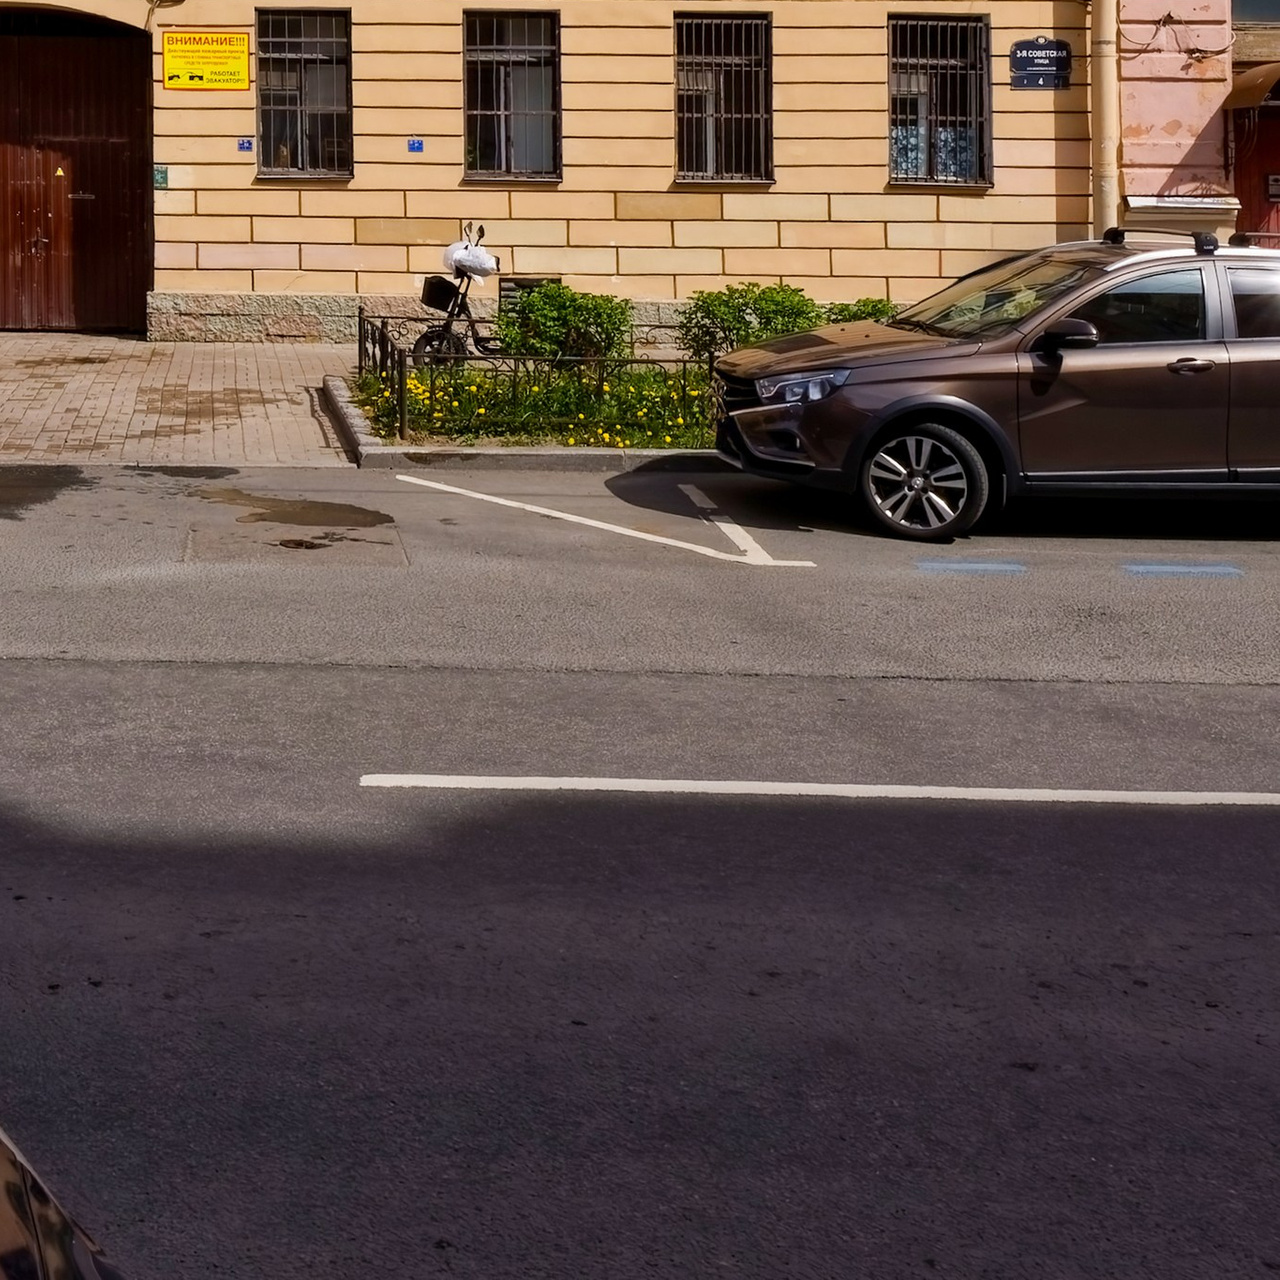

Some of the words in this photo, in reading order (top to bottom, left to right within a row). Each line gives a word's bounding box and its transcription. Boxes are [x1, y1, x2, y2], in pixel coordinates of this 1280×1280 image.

[167, 36, 245, 46] ВНИМАНИЕ!!!
[1016, 50, 1027, 58] 3-Я
[1038, 77, 1043, 85] 4
